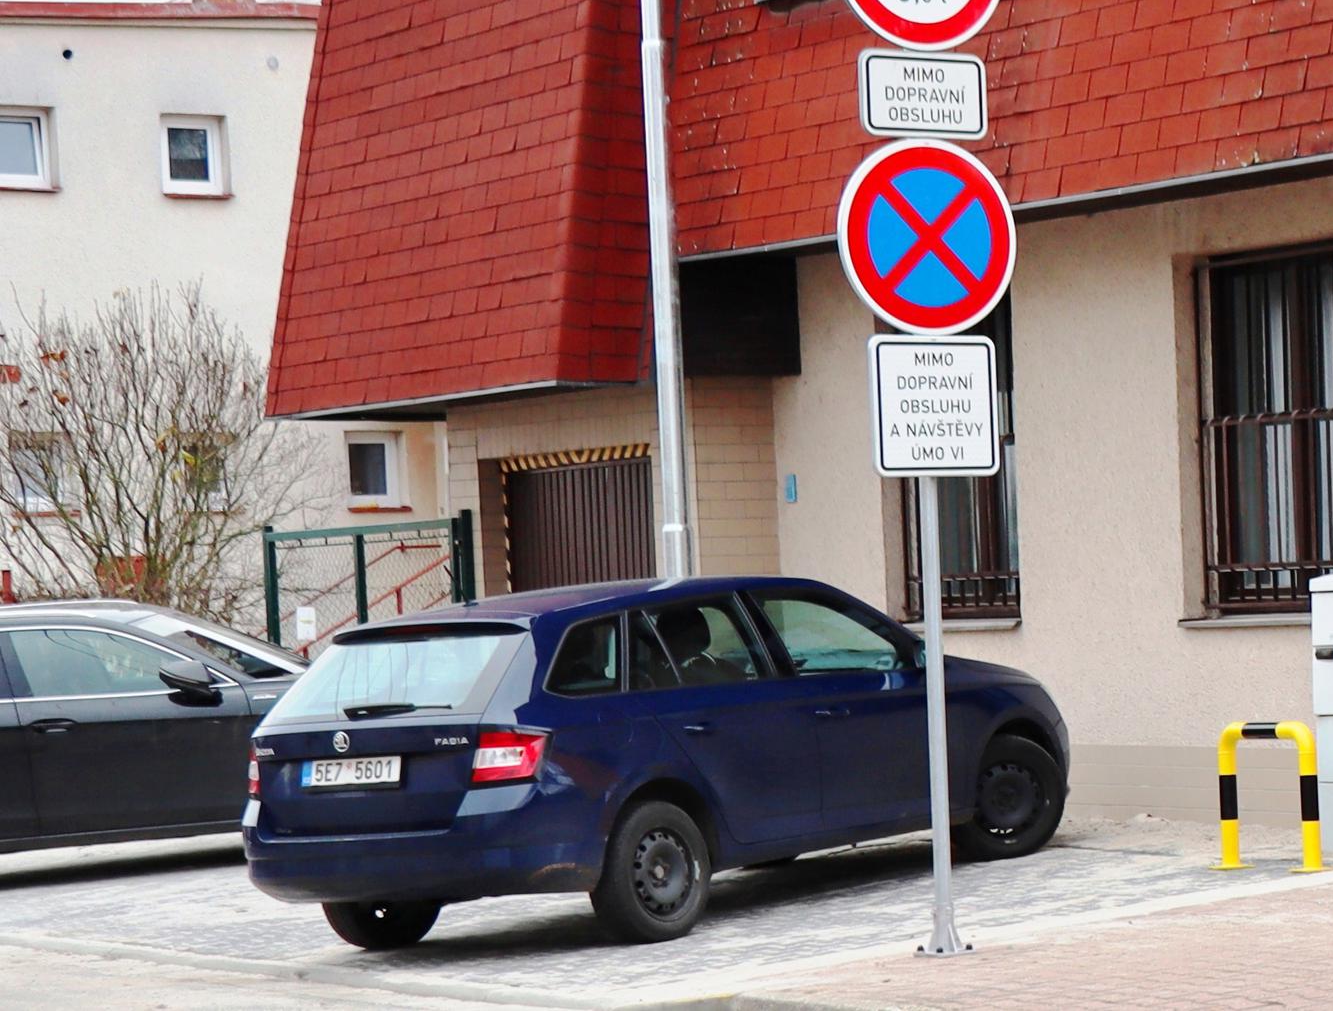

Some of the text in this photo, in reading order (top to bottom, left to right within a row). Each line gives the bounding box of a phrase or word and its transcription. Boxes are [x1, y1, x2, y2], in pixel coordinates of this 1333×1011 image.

[903, 66, 945, 83] MIMO
[884, 85, 965, 104] DOPRAVNÍ
[888, 106, 963, 124] OBSLUHU
[914, 352, 954, 366] MIMO
[897, 372, 974, 390] DOPRAVNÍ
[900, 399, 972, 414] OBSLUHU
[890, 419, 983, 437] A NÁVŠTĚVY
[911, 444, 964, 461] ÚMO VI
[434, 737, 469, 746] FABIA
[314, 760, 393, 782] 5E7 5601
